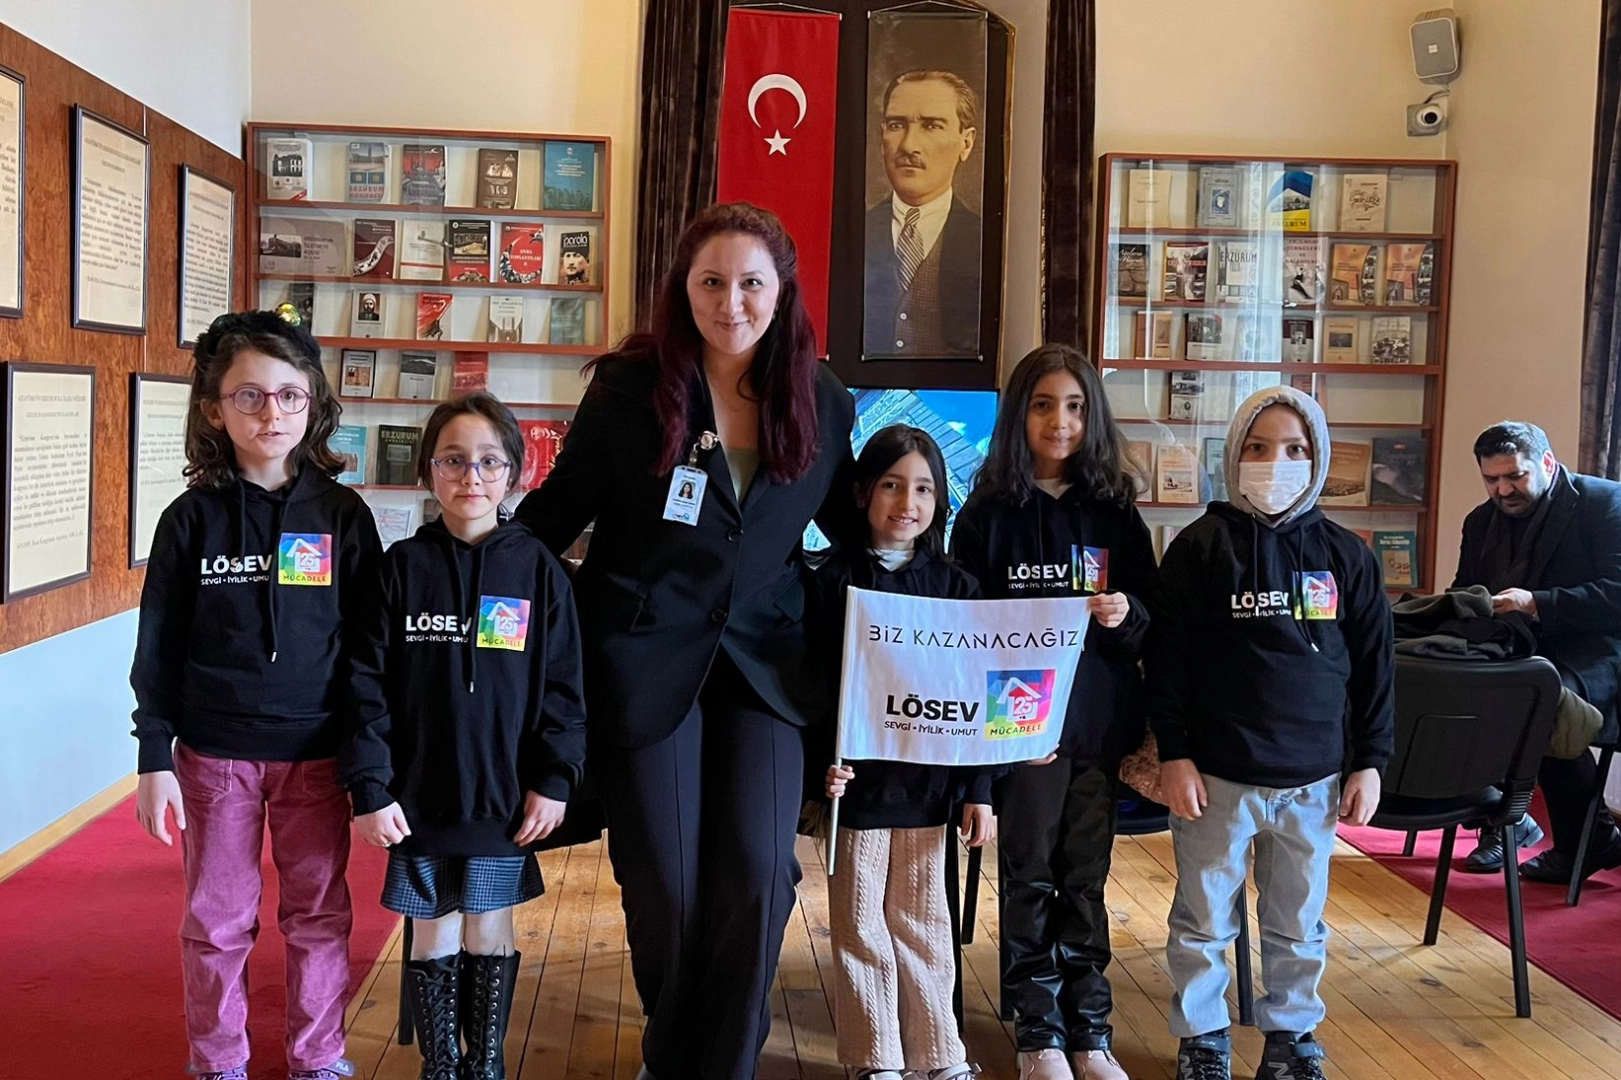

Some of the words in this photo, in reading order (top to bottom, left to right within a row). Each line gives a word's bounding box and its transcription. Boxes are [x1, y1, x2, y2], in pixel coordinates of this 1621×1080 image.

[1219, 251, 1258, 263] ERZURUM
[381, 430, 419, 440] ERZURUM
[201, 554, 273, 575] LÖSEV
[1008, 563, 1068, 580] LÖSEV
[201, 576, 221, 586] SEVGİ
[227, 576, 249, 584] İYİLİK
[1231, 591, 1289, 609] LÖSEV
[405, 612, 472, 635] LÖSEV
[405, 634, 425, 642] SEVGİ
[429, 634, 448, 642] İYİLİK
[452, 635, 469, 643] UMU
[869, 625, 903, 644] BİZ
[913, 627, 1079, 649] KAZANACAĞIZ
[886, 694, 979, 722] LÖSEV
[1013, 696, 1033, 714] 25
[884, 721, 911, 731] SEVGİ
[918, 724, 944, 735] İYİLİK
[951, 728, 978, 736] UMUT
[989, 724, 1042, 736] MÜCADELE
